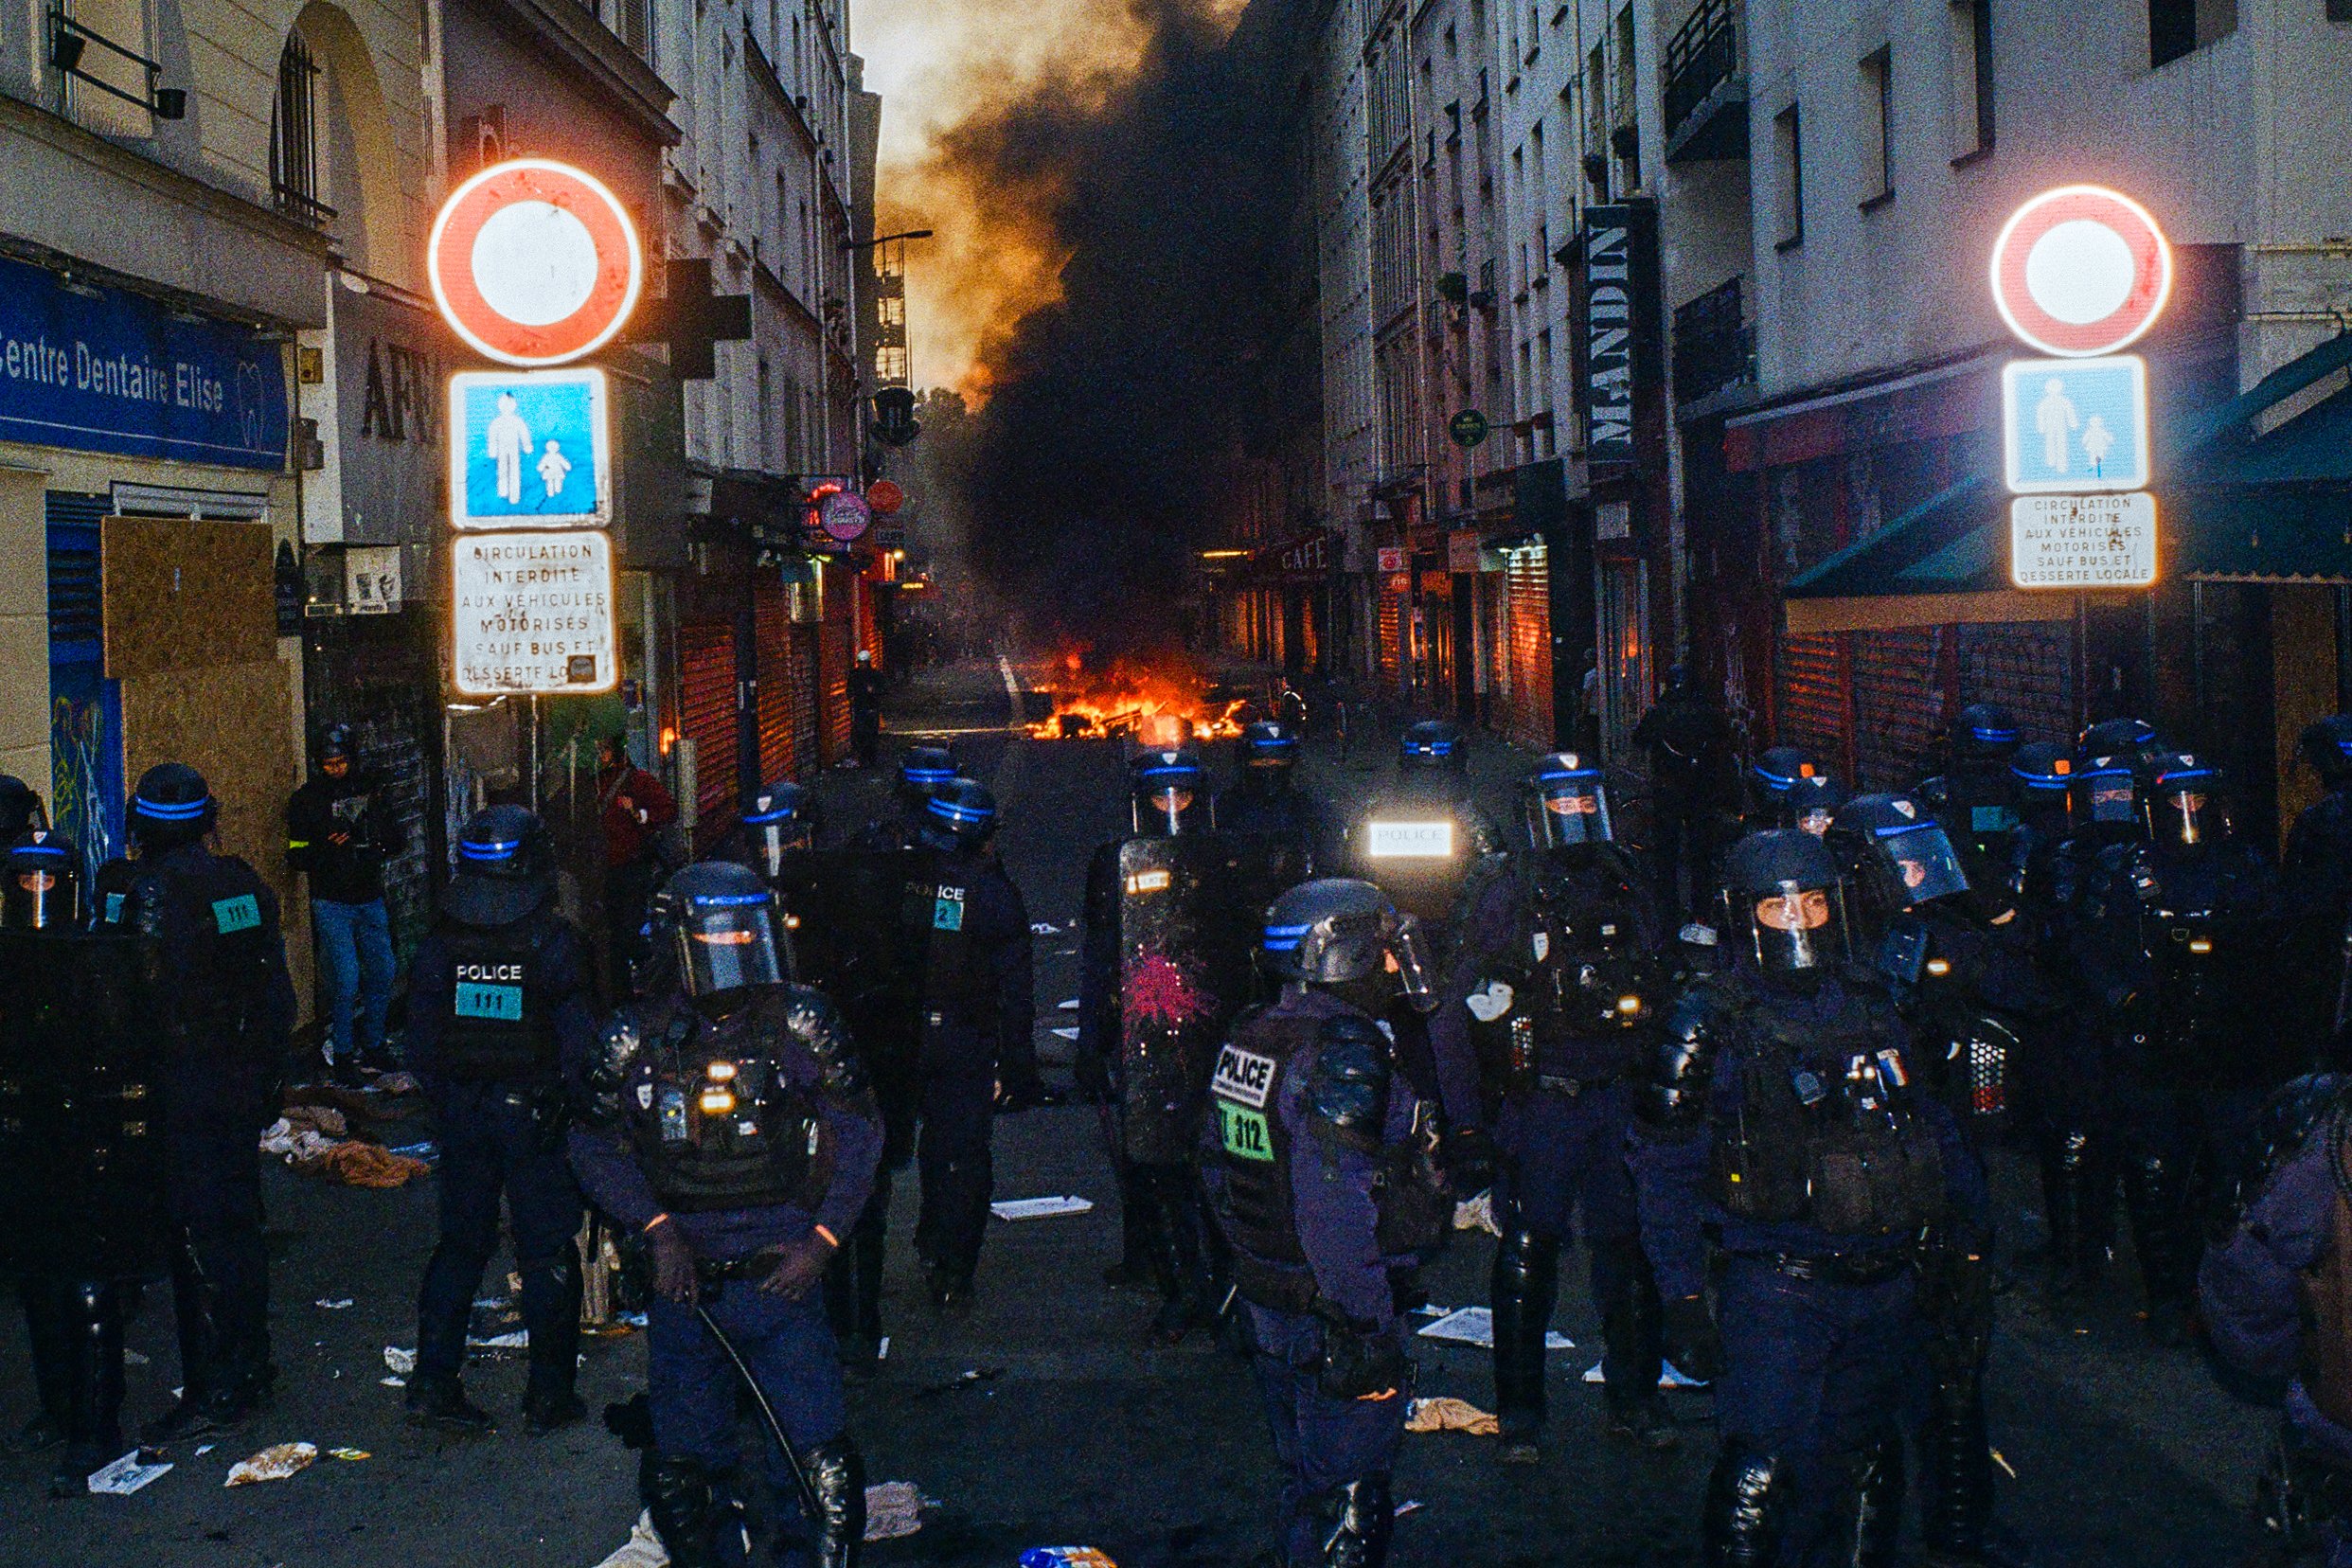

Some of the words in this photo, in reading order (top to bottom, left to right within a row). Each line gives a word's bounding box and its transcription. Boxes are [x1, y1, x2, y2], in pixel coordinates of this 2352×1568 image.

[1589, 223, 1631, 444] MANDIN
[0, 334, 68, 386] entre
[77, 340, 168, 403] Dentaire
[176, 362, 223, 413] Elise
[2035, 498, 2131, 511] CIRCULATION
[2045, 512, 2121, 525] INTERDITE
[2025, 528, 2052, 539] AUX
[474, 544, 593, 561] CIRCULATION
[2038, 556, 2074, 567] SAUF
[2079, 555, 2108, 566] BUS
[2114, 554, 2131, 565] ET
[485, 567, 580, 584] INTERDITE
[2020, 570, 2090, 583] DESSERTE
[2095, 568, 2148, 580] LOCALE
[462, 596, 495, 608] AUX
[476, 642, 522, 655] SAUF
[530, 641, 566, 655] BUS
[1378, 829, 1444, 841] POLICE
[228, 904, 249, 923] 111
[456, 964, 523, 980] POLICE
[475, 992, 503, 1011] 111
